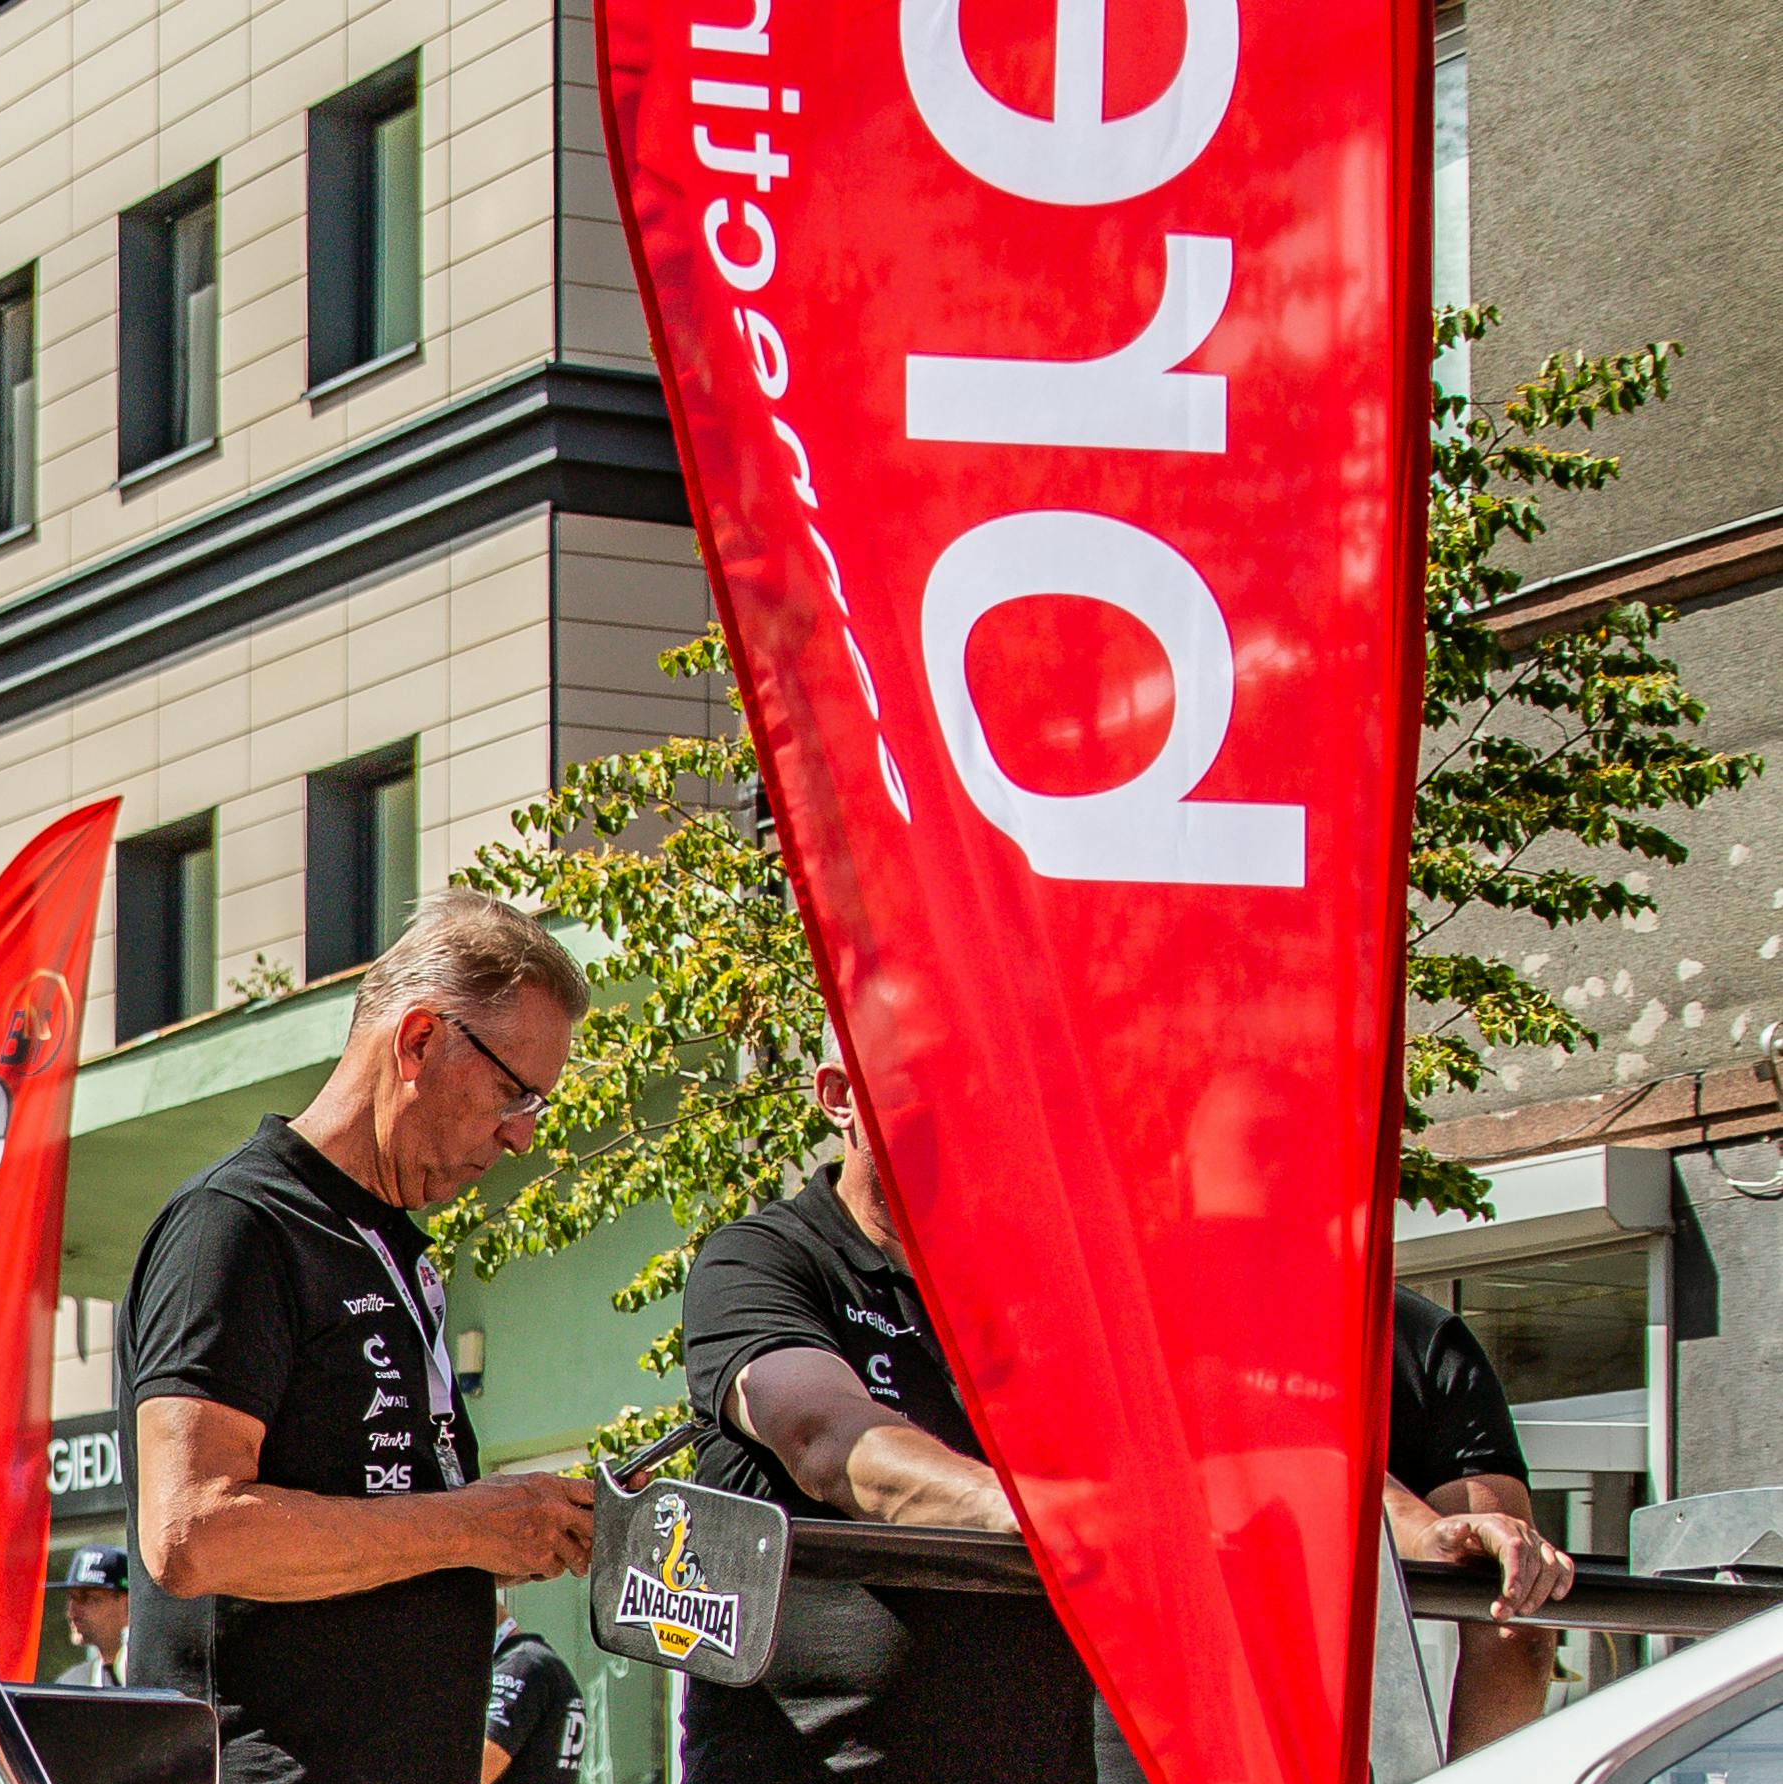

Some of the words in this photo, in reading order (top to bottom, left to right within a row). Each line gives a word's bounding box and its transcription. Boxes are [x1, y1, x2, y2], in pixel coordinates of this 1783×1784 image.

[845, 1303, 907, 1338] breitto
[364, 1462, 412, 1489] DAS
[621, 1572, 734, 1648] ANACONDA
[658, 1629, 691, 1648] RACING
